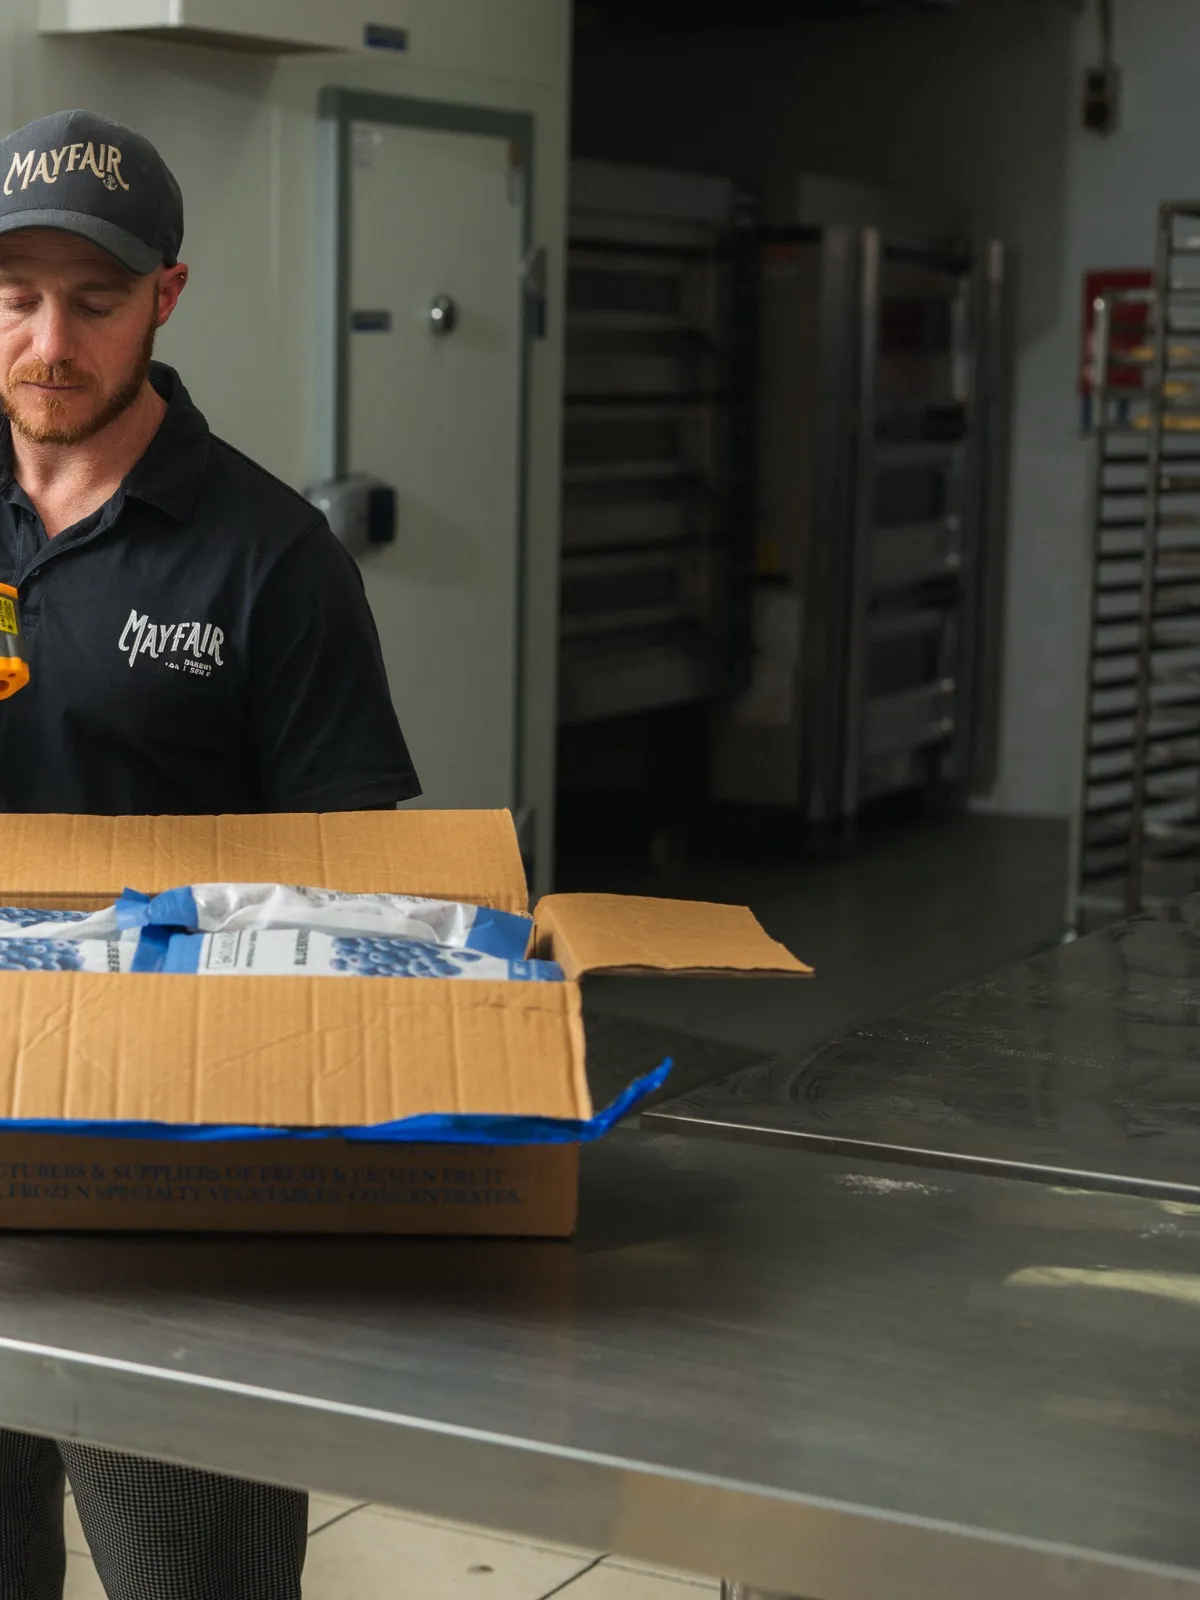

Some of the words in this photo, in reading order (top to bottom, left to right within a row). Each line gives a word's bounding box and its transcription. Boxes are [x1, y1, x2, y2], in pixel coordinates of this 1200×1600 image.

[3, 141, 130, 196] MAYFAIR
[118, 608, 224, 667] MAYFAIR
[8, 1182, 90, 1200] FROZEN
[91, 1162, 105, 1180] &
[112, 1164, 220, 1181] SUPPLIERS
[225, 1165, 254, 1181] OF
[259, 1165, 328, 1183] FRESH
[352, 1166, 435, 1184] FROZEN
[440, 1167, 506, 1184] FRUIT
